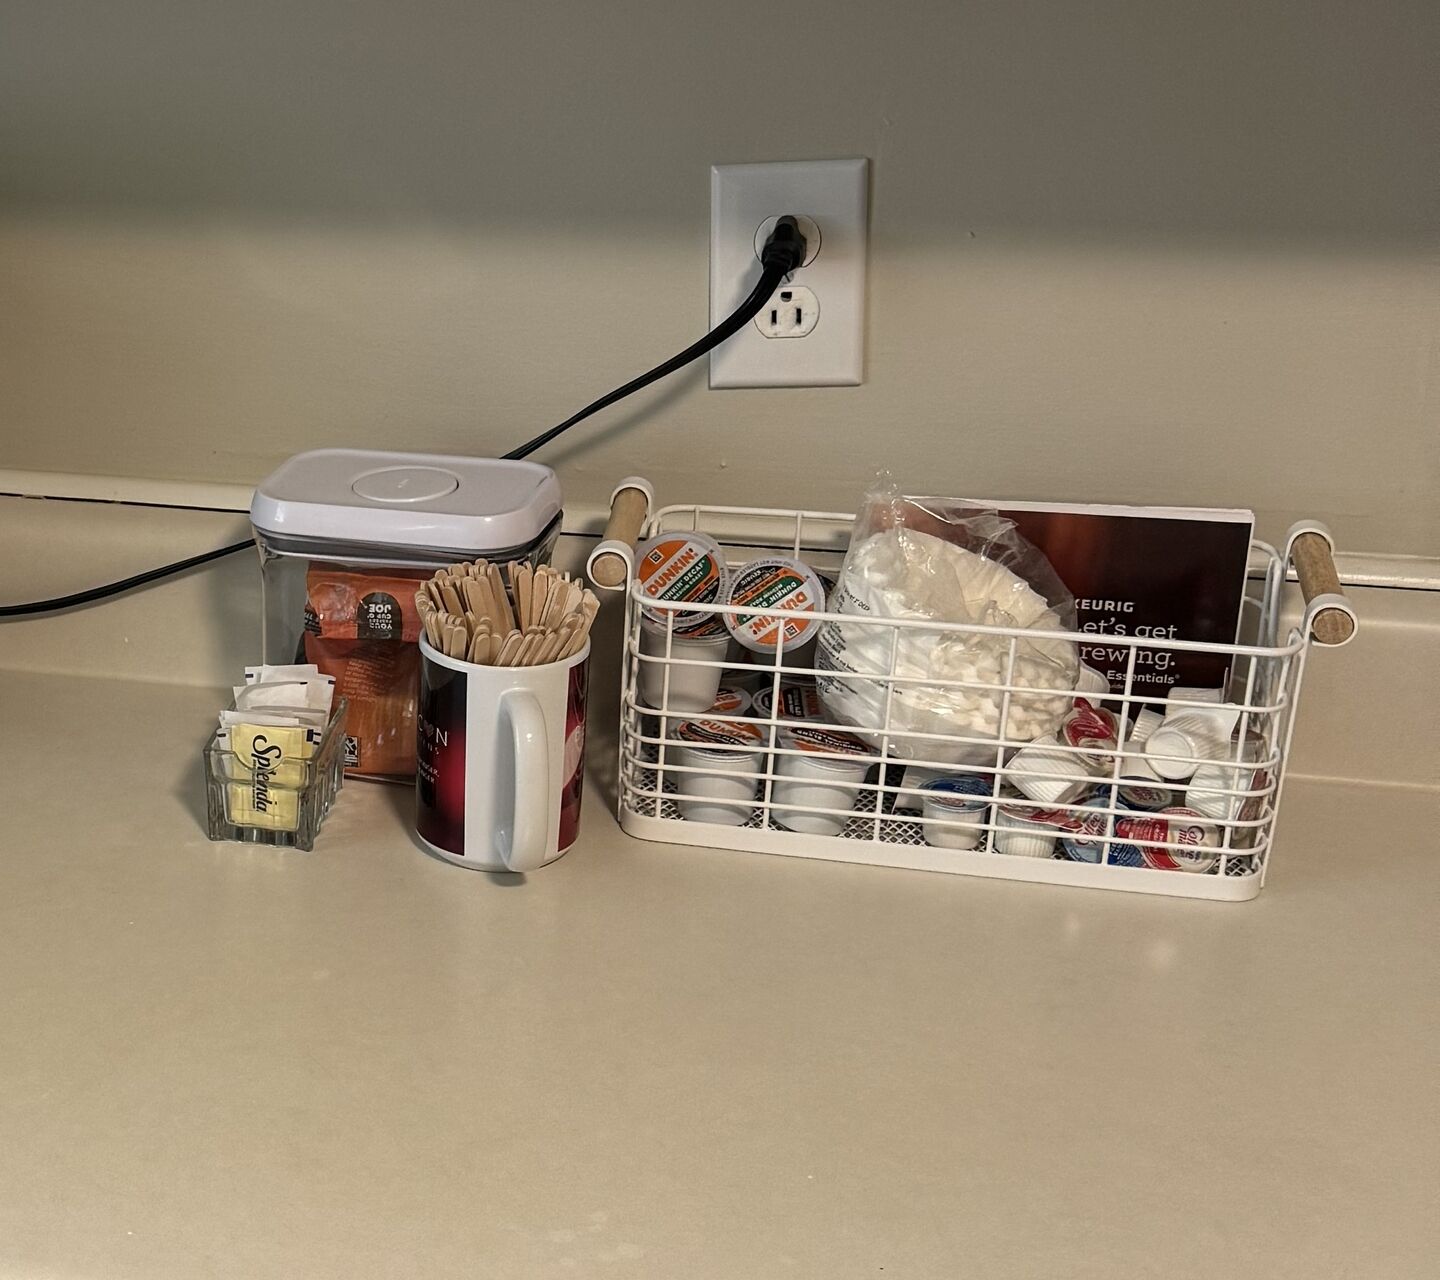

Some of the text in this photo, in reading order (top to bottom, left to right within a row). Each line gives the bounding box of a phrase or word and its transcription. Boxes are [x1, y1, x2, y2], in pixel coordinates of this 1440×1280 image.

[646, 548, 695, 597] DUNKIN'
[661, 579, 685, 600] UNKIN'
[368, 603, 392, 613] JOE
[1079, 616, 1126, 636] et's
[1080, 646, 1176, 670] rewng.
[1106, 669, 1175, 685] Essntials
[251, 734, 283, 813] Splenda
